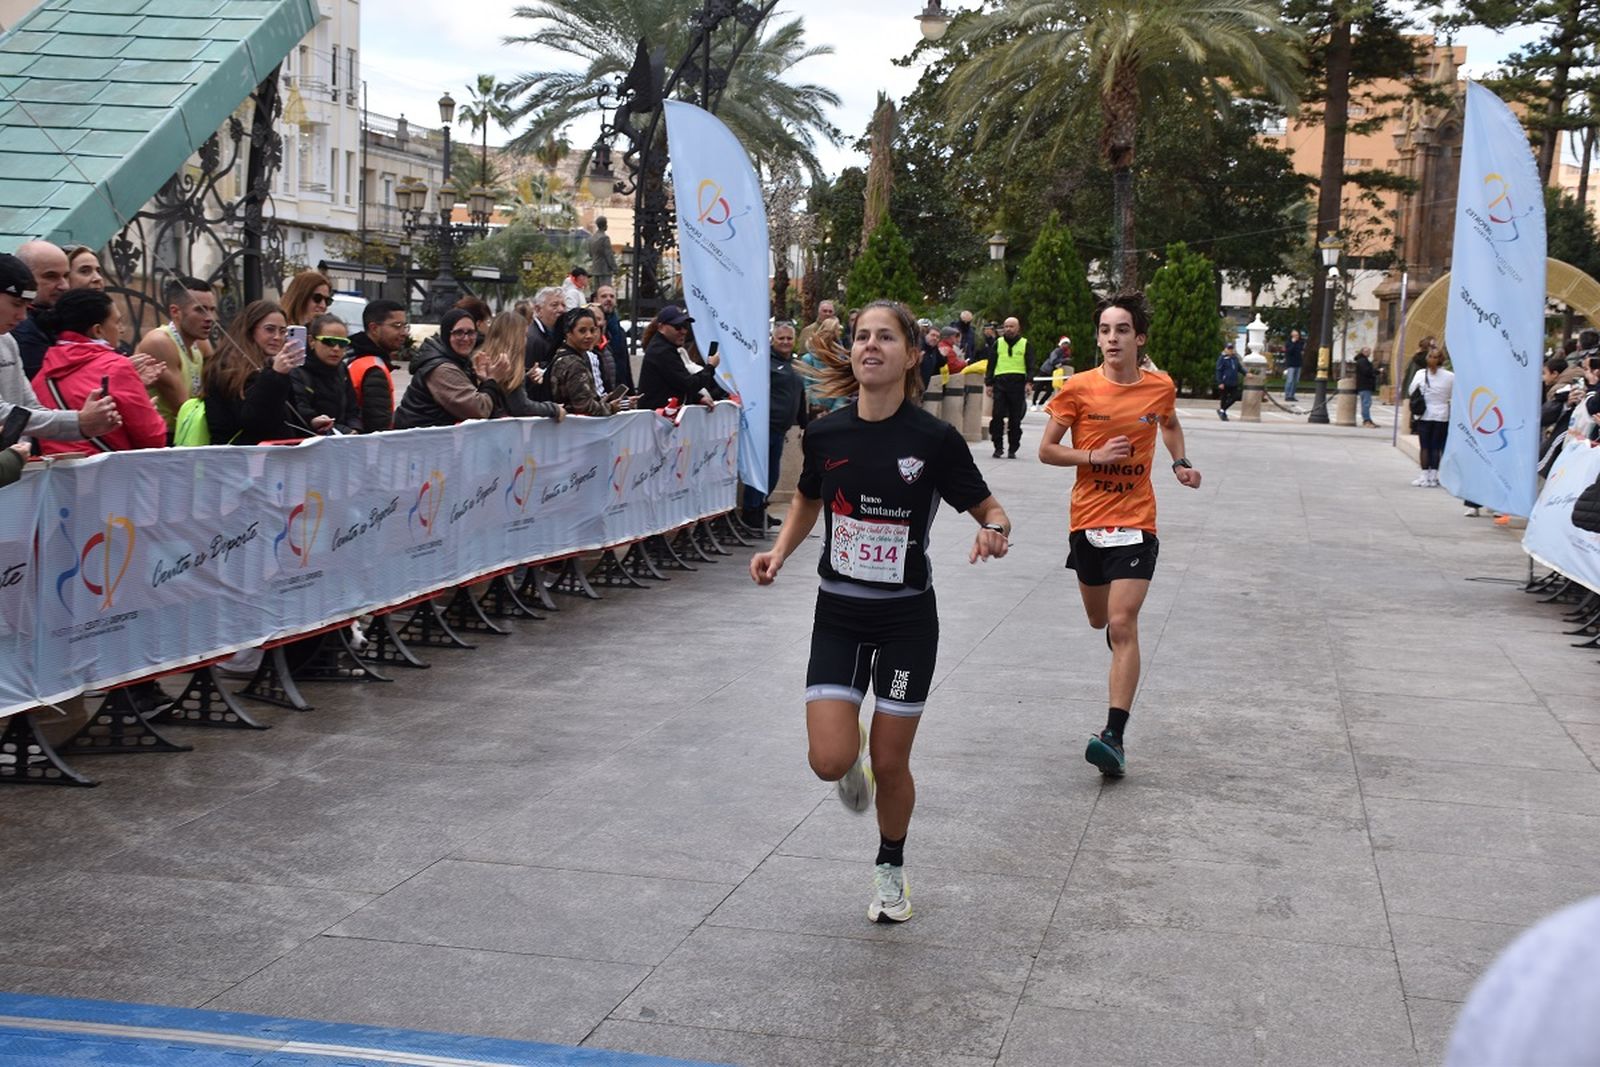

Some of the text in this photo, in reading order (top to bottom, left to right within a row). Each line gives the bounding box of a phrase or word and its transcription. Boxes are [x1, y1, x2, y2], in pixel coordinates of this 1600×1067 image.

[1091, 463, 1145, 476] DINGO
[860, 494, 882, 504] Banco
[860, 503, 912, 518] Santander
[209, 520, 259, 563] Deporte
[858, 543, 898, 564] 514
[893, 669, 910, 681] THE
[891, 679, 908, 690] COR
[889, 688, 906, 700] NER
